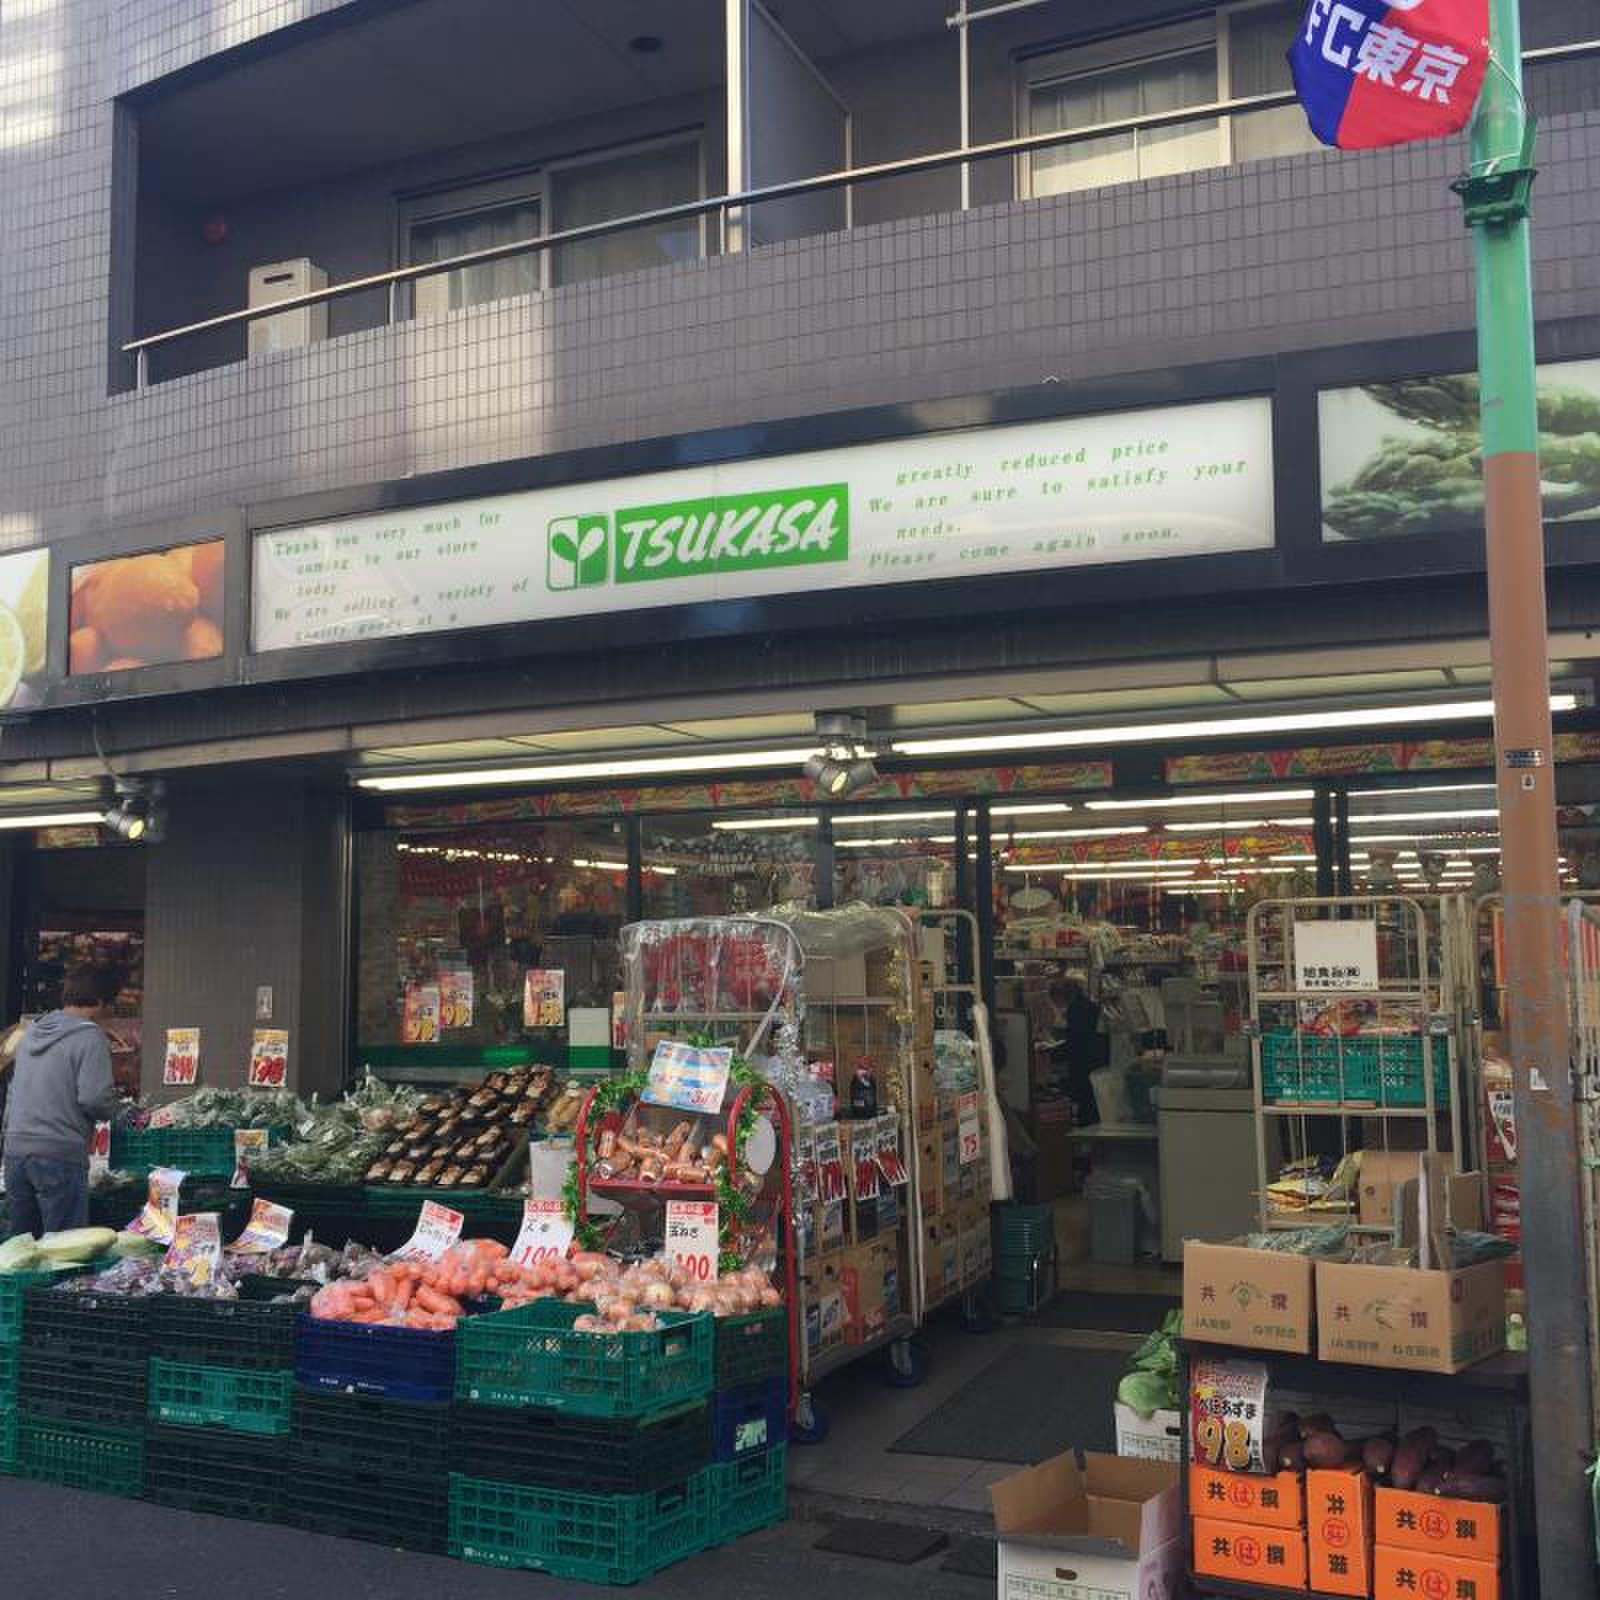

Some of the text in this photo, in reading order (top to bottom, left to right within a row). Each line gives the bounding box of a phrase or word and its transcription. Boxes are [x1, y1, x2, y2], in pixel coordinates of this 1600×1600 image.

[896, 438, 1169, 486] greatly reduced price
[869, 459, 1247, 513] We are sure to satisfy your
[274, 541, 320, 557] Thank
[424, 517, 461, 533] much
[479, 512, 501, 526] for
[437, 541, 478, 556] store
[621, 497, 839, 570] TSUKASA
[868, 527, 1179, 568] Please come again soon.
[896, 522, 961, 540] needs.
[1198, 1418, 1250, 1468] 98
